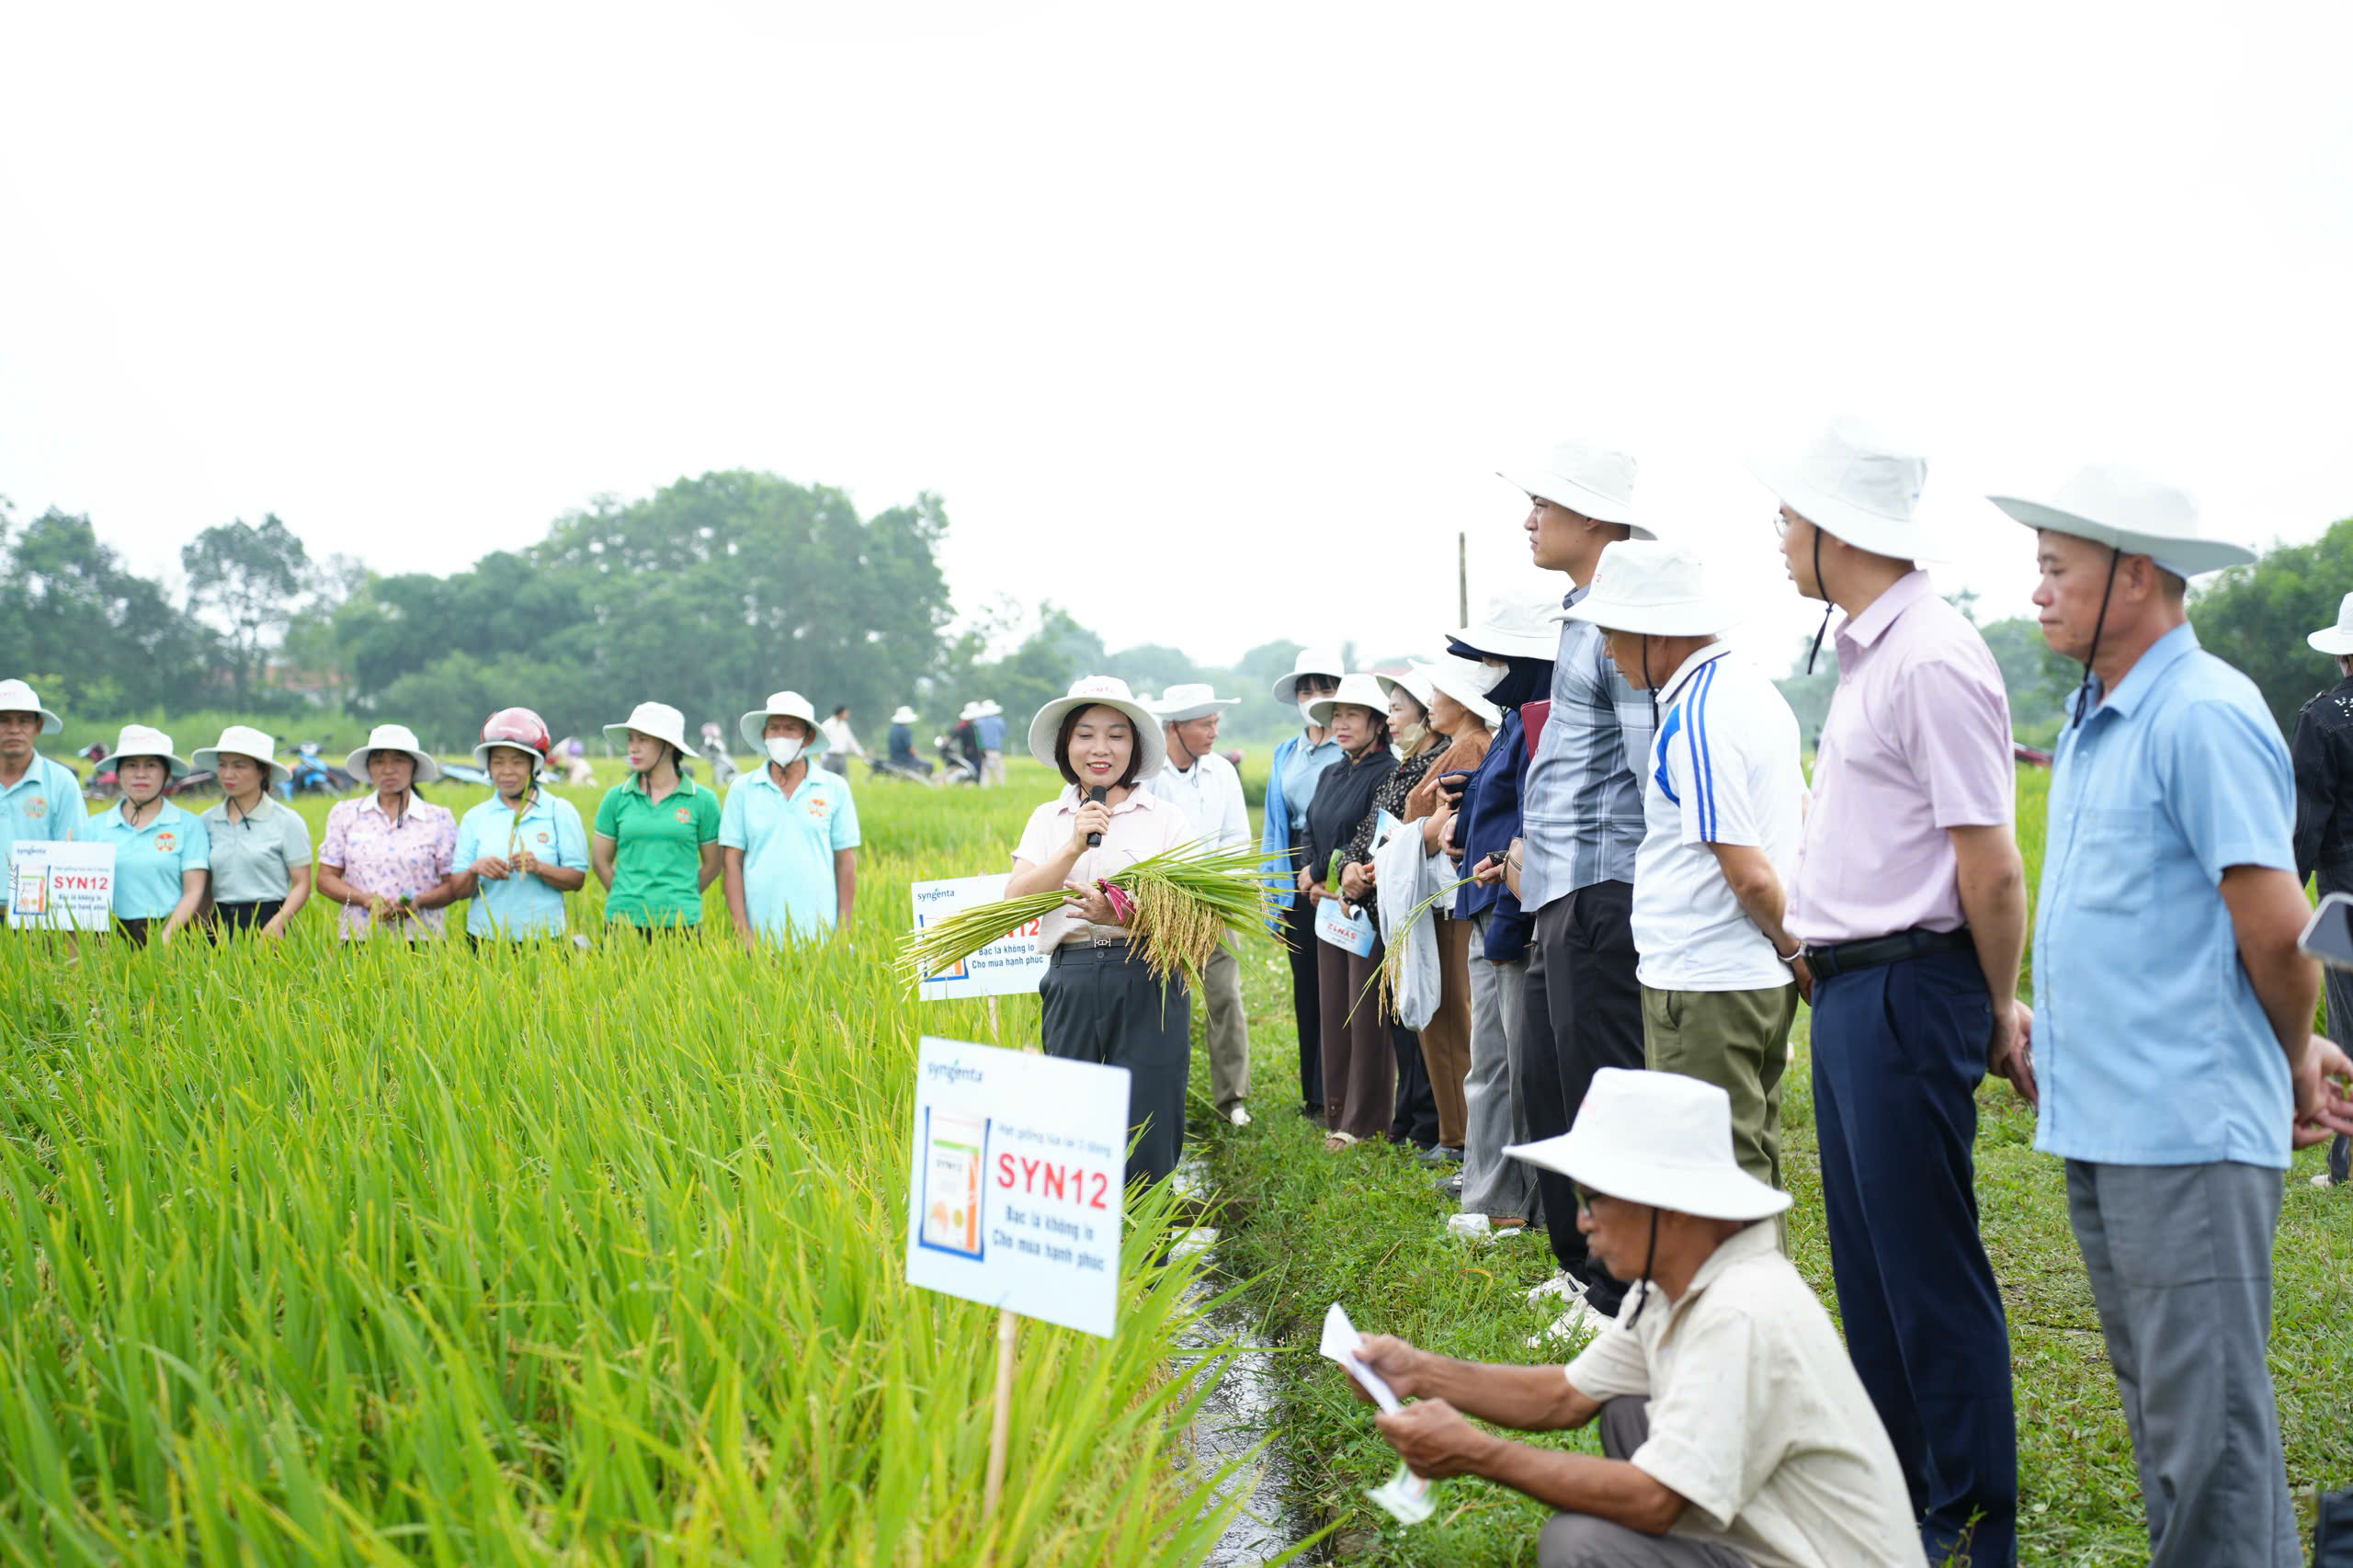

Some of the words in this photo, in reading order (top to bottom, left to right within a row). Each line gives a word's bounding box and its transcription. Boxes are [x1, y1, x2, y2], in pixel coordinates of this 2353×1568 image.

[54, 875, 108, 890] SYN12
[917, 888, 955, 903] syngenta
[972, 960, 986, 969] Cho
[927, 1060, 983, 1084] syngenta
[997, 1153, 1108, 1210] SYN12
